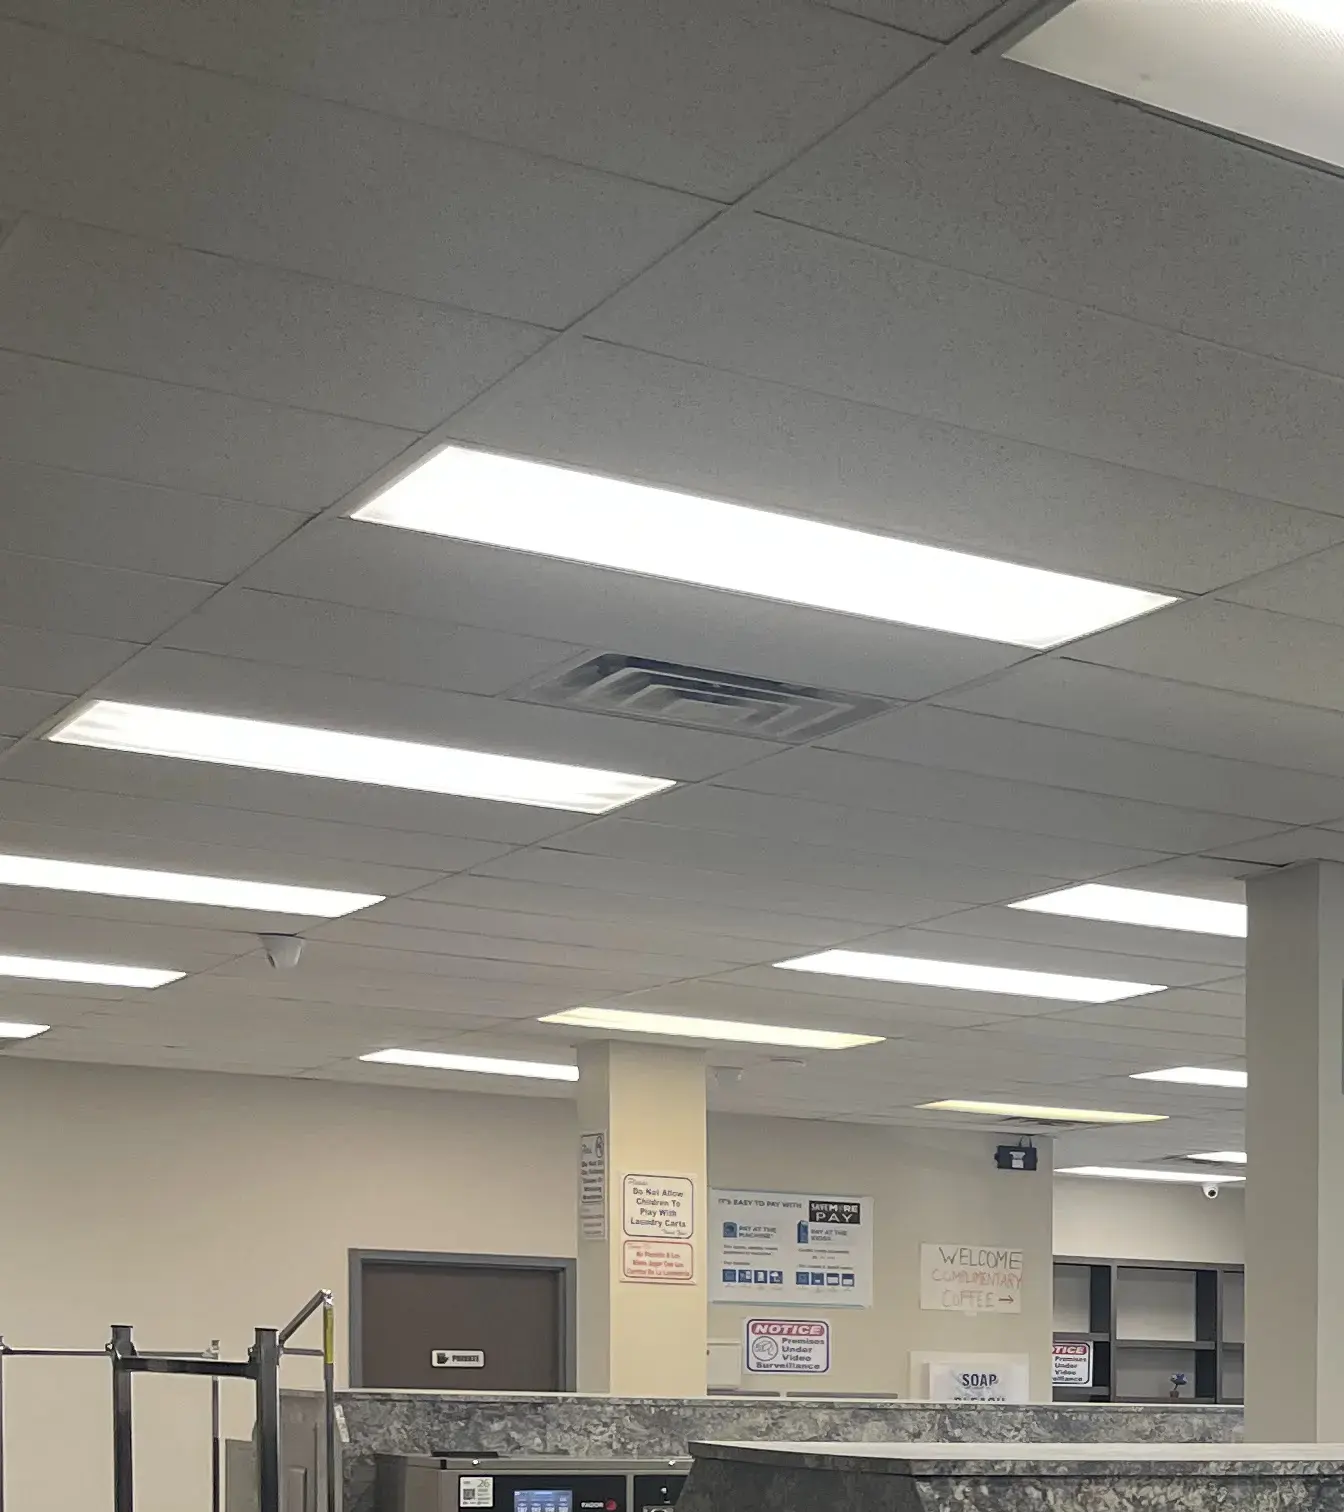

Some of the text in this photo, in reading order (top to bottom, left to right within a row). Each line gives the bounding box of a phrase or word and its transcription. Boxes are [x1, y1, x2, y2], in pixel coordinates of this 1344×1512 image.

[662, 1190, 684, 1198] Allow
[767, 1200, 781, 1208] PAY
[640, 1208, 658, 1218] Play
[815, 1212, 853, 1222] PAY
[939, 1247, 1023, 1269] WELCOME
[942, 1290, 995, 1308] COFFEE
[754, 1324, 822, 1335] NOTICE
[782, 1337, 825, 1345] Premises
[1052, 1345, 1086, 1354] TICE
[756, 1361, 820, 1370] Surveillance
[962, 1373, 998, 1387] SOAP
[477, 1479, 490, 1488] 26
